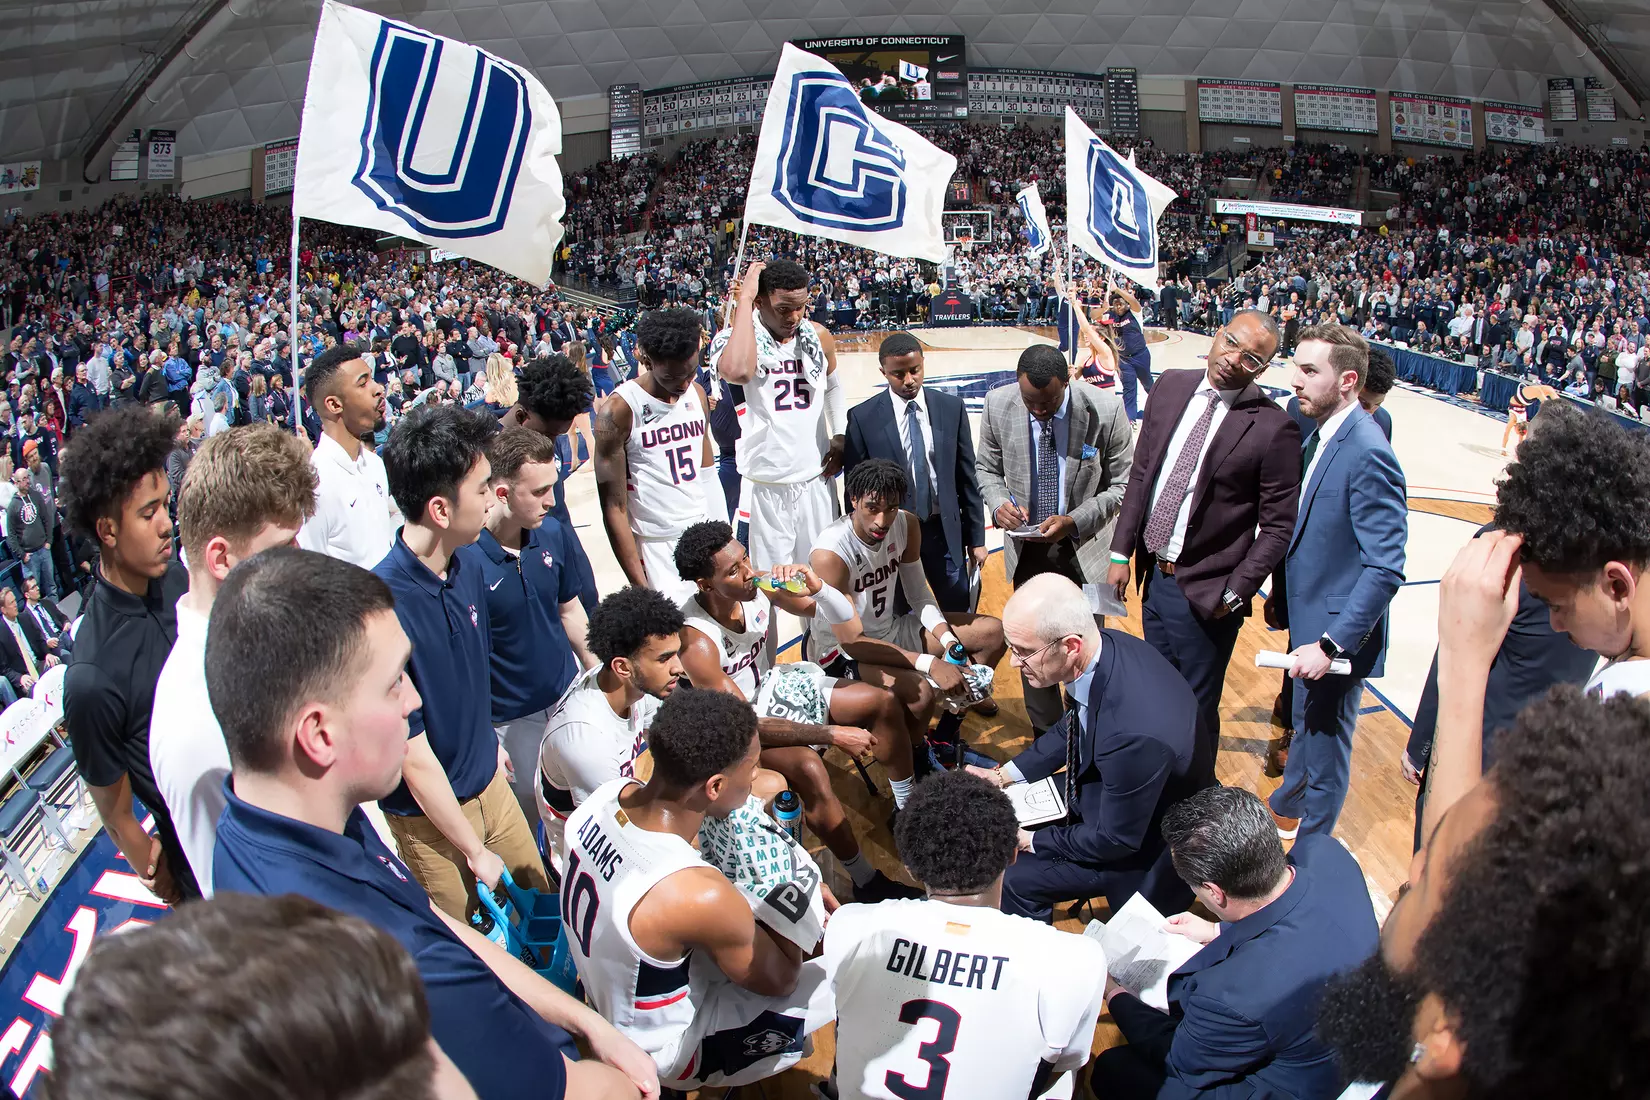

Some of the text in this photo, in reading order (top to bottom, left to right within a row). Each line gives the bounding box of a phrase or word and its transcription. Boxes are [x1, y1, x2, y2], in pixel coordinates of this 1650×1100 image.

[805, 38, 863, 49] UNIVERSITY
[881, 37, 950, 45] CONNECTICUT
[1042, 84, 1050, 92] 31
[1092, 88, 1100, 97] 14
[1415, 94, 1466, 103] CHAMPIONSHIP
[646, 105, 658, 113] 24
[663, 102, 675, 110] 50
[682, 100, 692, 108] 21
[1008, 103, 1017, 111] 30
[352, 19, 532, 238] U
[153, 143, 171, 154] 873
[774, 378, 811, 412] 25
[641, 419, 704, 448] UCONN
[665, 445, 696, 485] 15
[854, 556, 901, 592] UCONN
[872, 586, 887, 618] 5
[577, 814, 623, 882] ADAMS
[563, 848, 600, 958] 10
[886, 938, 1009, 990] GILBERT
[885, 998, 962, 1100] 3
